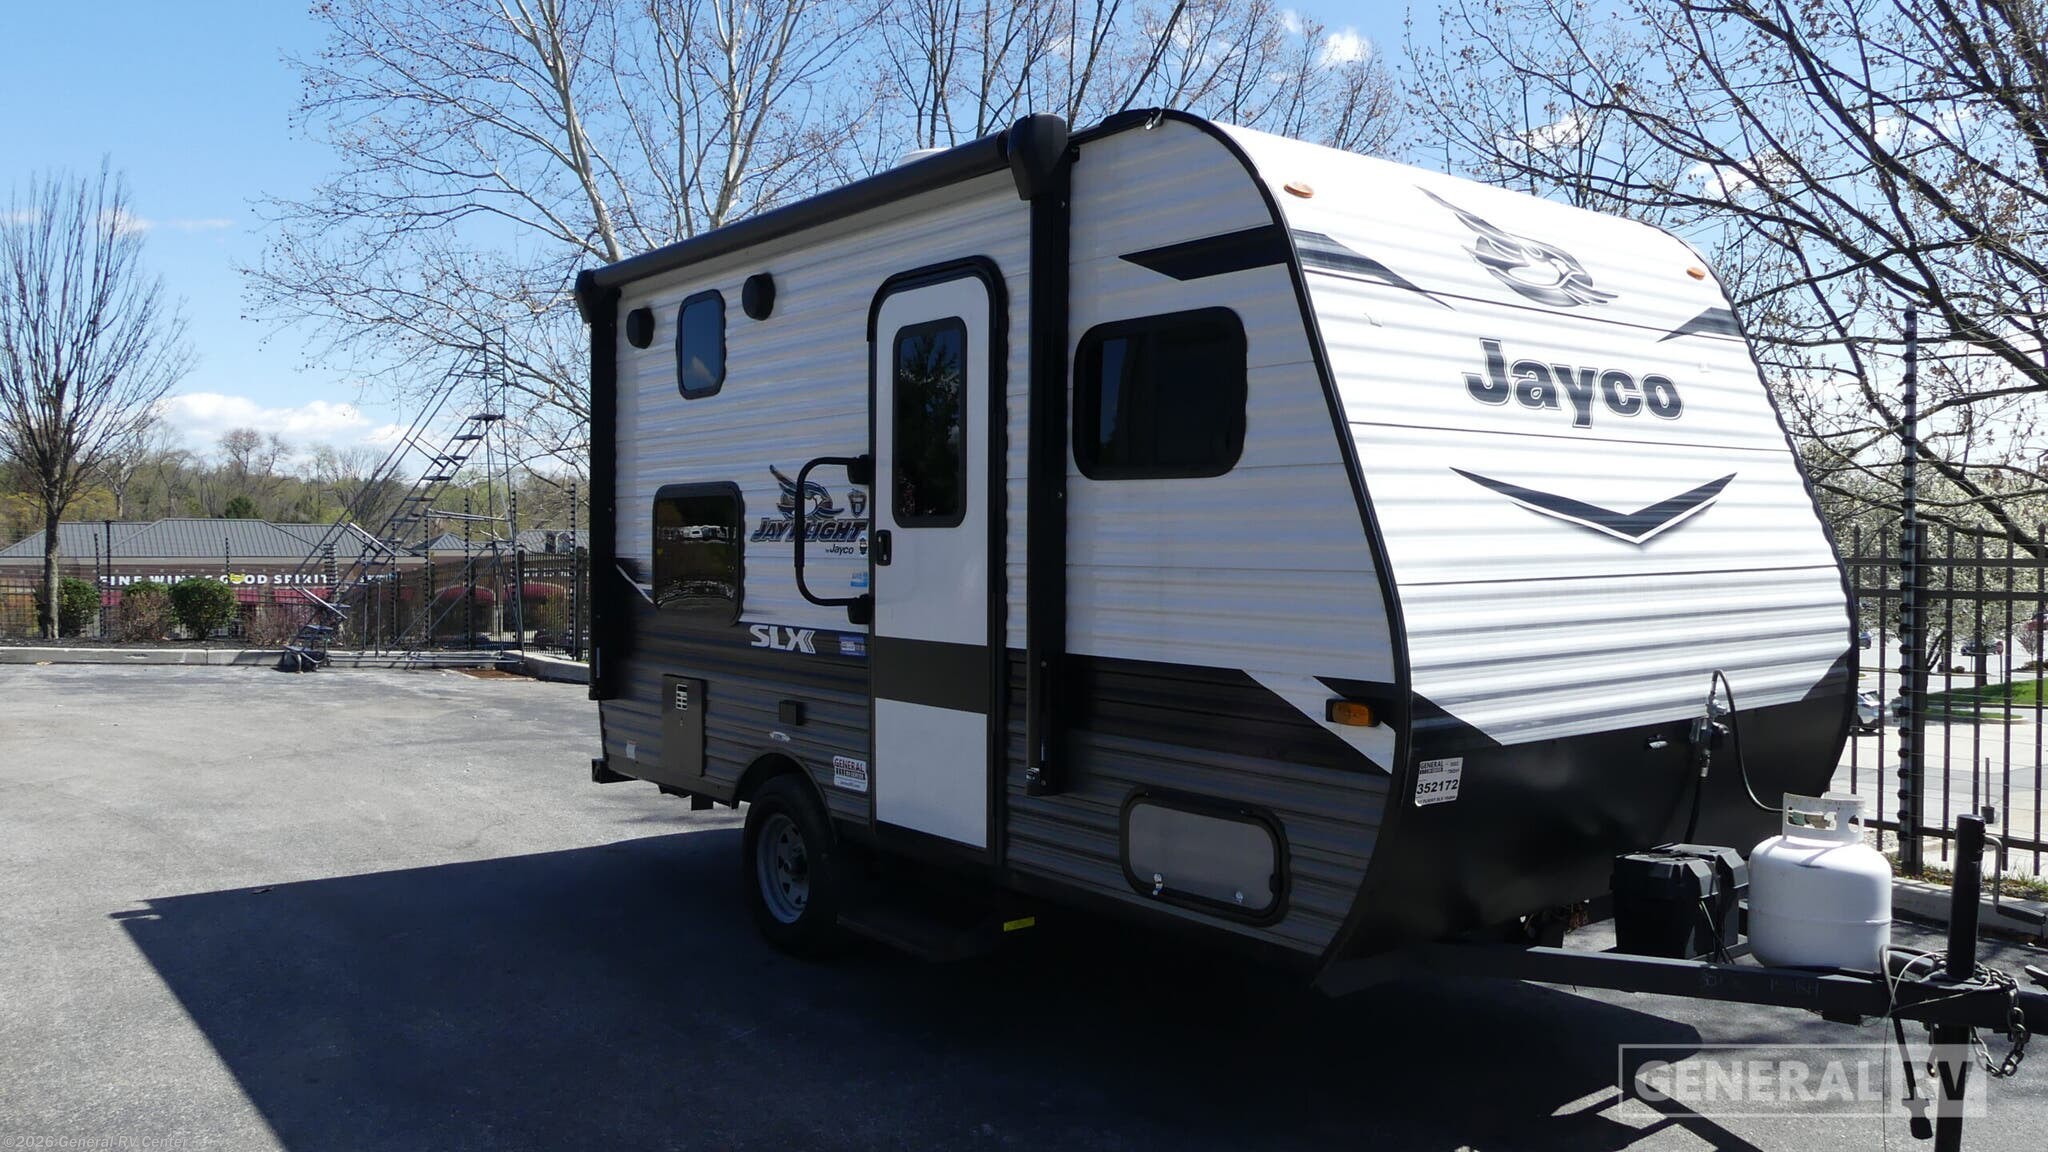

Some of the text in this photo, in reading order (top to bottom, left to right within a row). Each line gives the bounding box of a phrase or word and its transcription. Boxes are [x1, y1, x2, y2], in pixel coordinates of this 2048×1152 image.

[1462, 337, 1684, 429] Jayco
[750, 517, 791, 543] JAY
[829, 544, 854, 555] Jayco
[99, 575, 143, 586] FINE
[273, 574, 335, 585] SPIRIT
[749, 624, 816, 655] SLX
[834, 757, 865, 773] GENERAL
[1420, 760, 1444, 769] GENERAL
[1416, 779, 1459, 795] 352172
